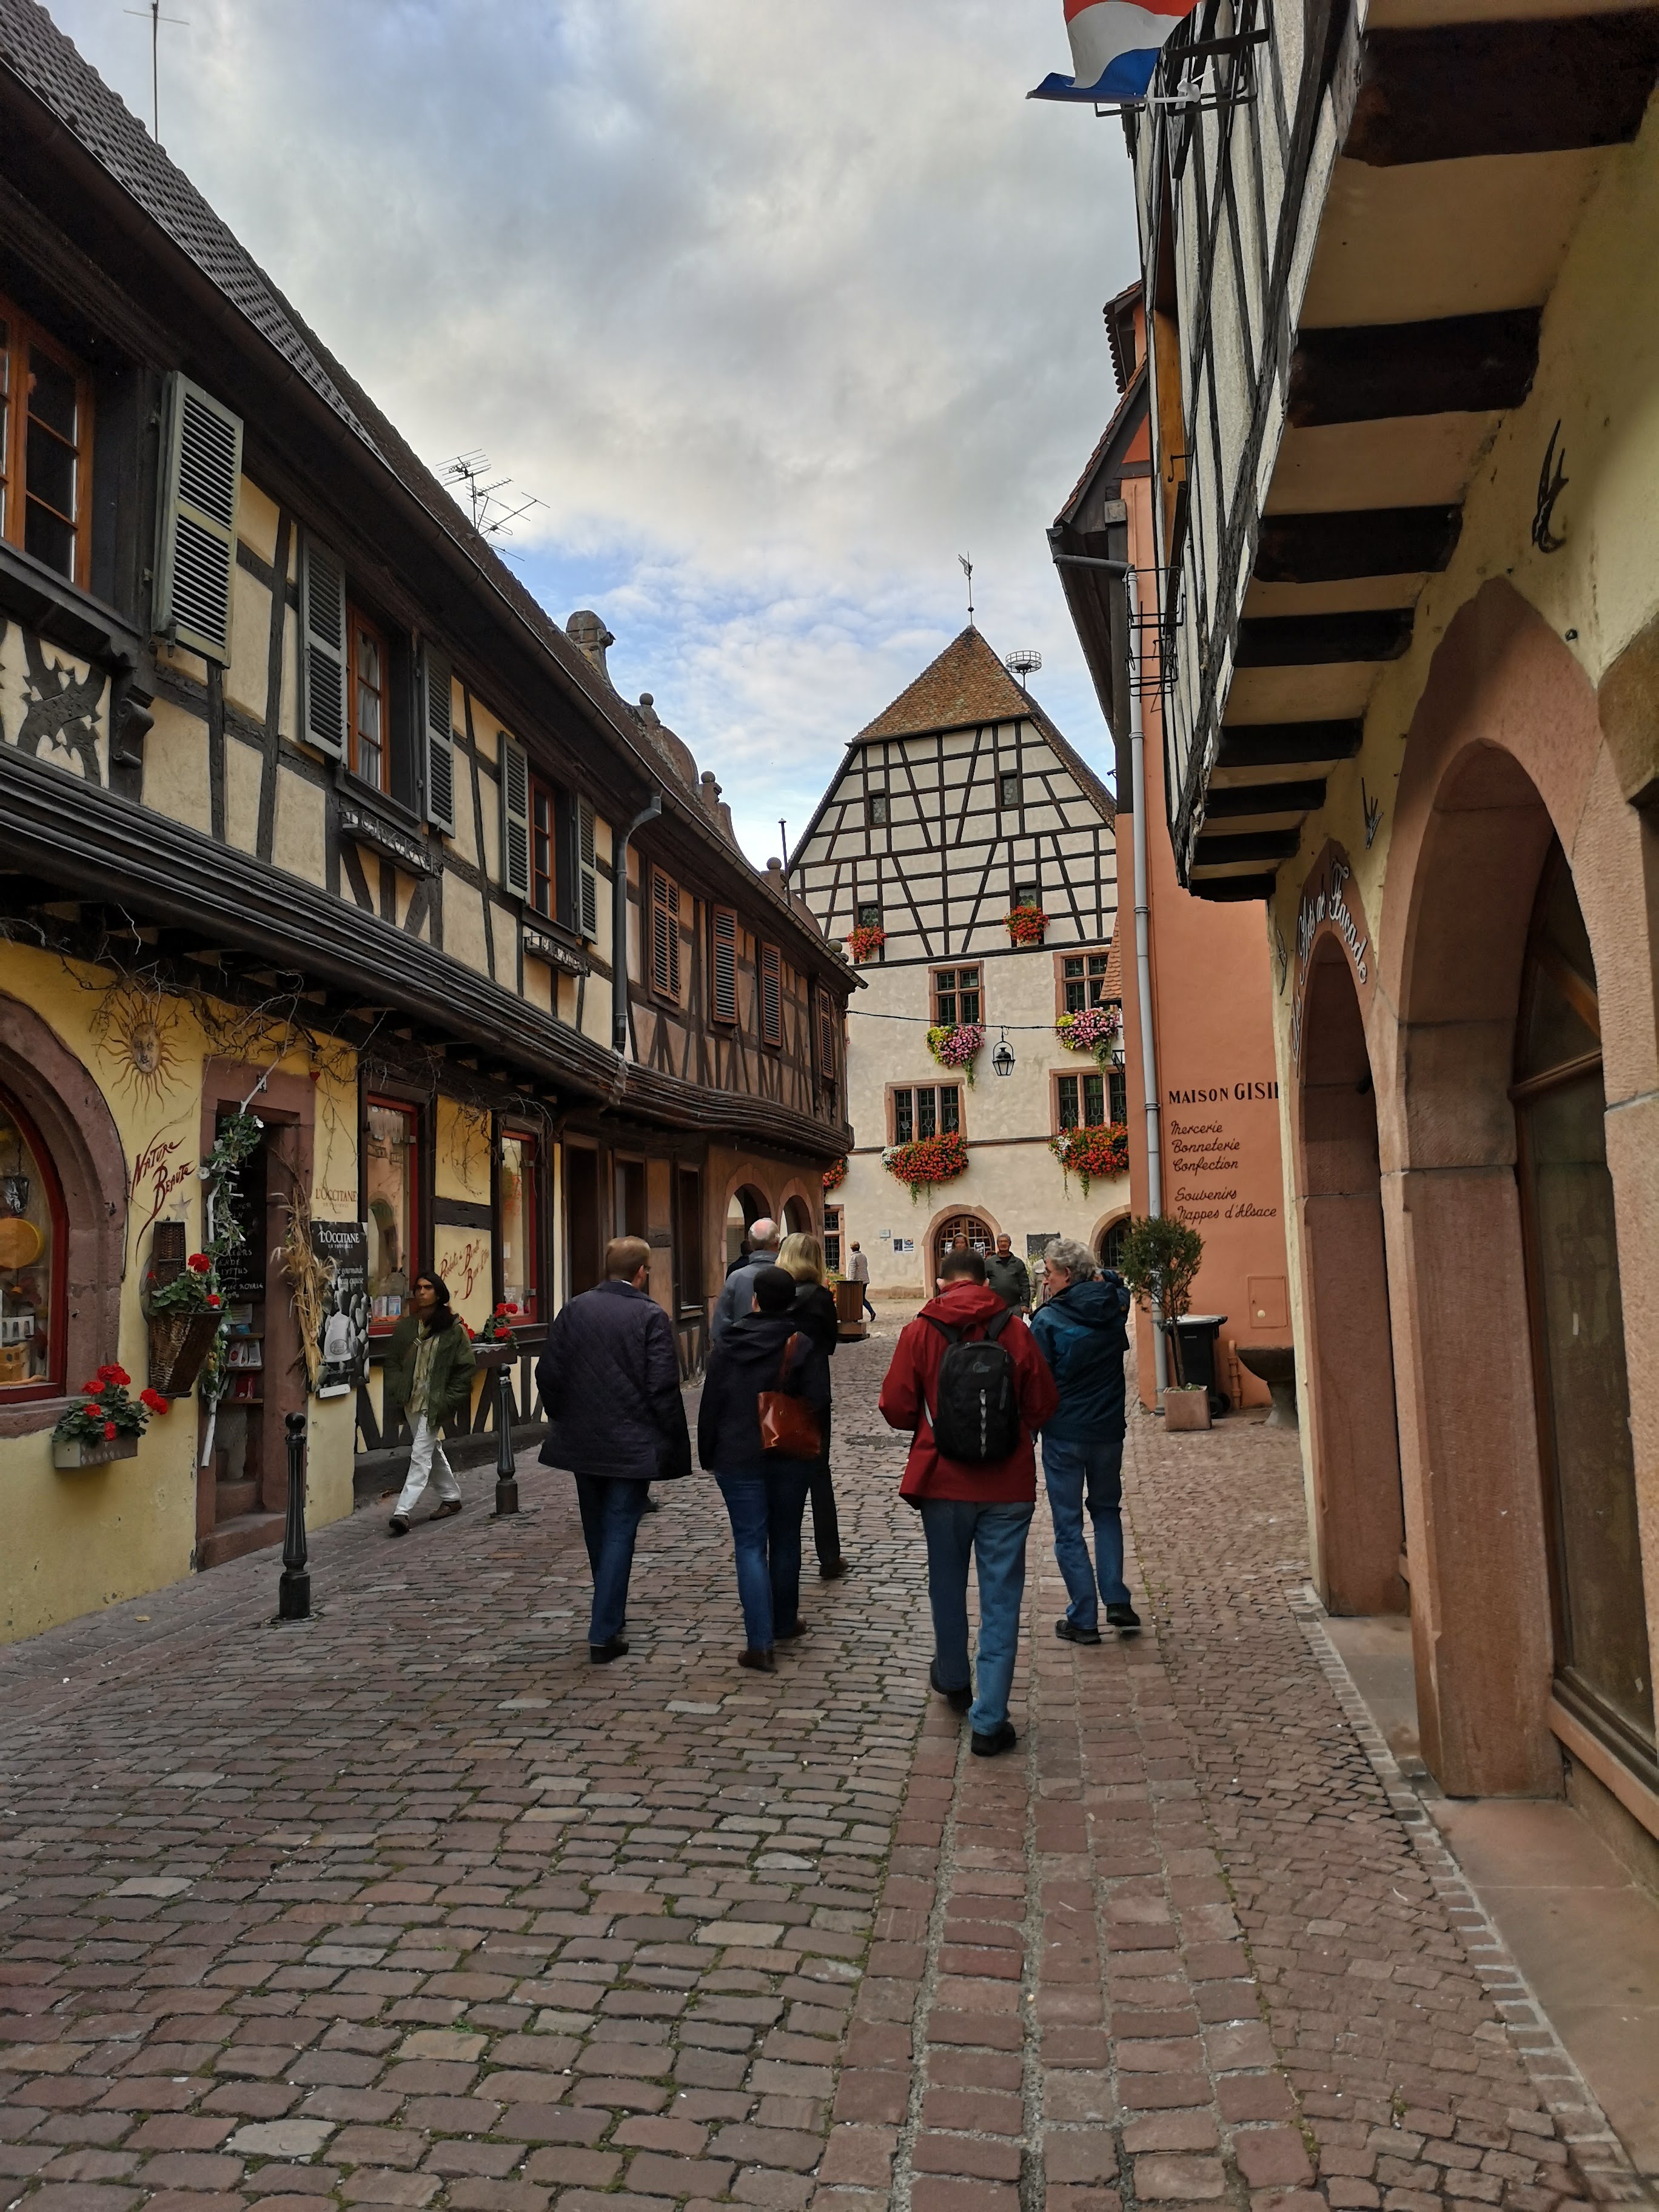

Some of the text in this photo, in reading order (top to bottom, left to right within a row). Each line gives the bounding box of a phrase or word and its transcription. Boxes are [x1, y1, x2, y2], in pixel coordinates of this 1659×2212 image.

[1169, 1087, 1228, 1104] MAISON
[1171, 1120, 1223, 1136] Mercerie
[1171, 1137, 1241, 1153] Bonneterie
[1173, 1156, 1239, 1176] Confection
[315, 1186, 357, 1202] L'OCCITANE
[1175, 1187, 1237, 1202] Souvenirs
[1178, 1203, 1277, 1225] Nappes d'Alsace
[320, 1230, 360, 1243] L'OCCITANE
